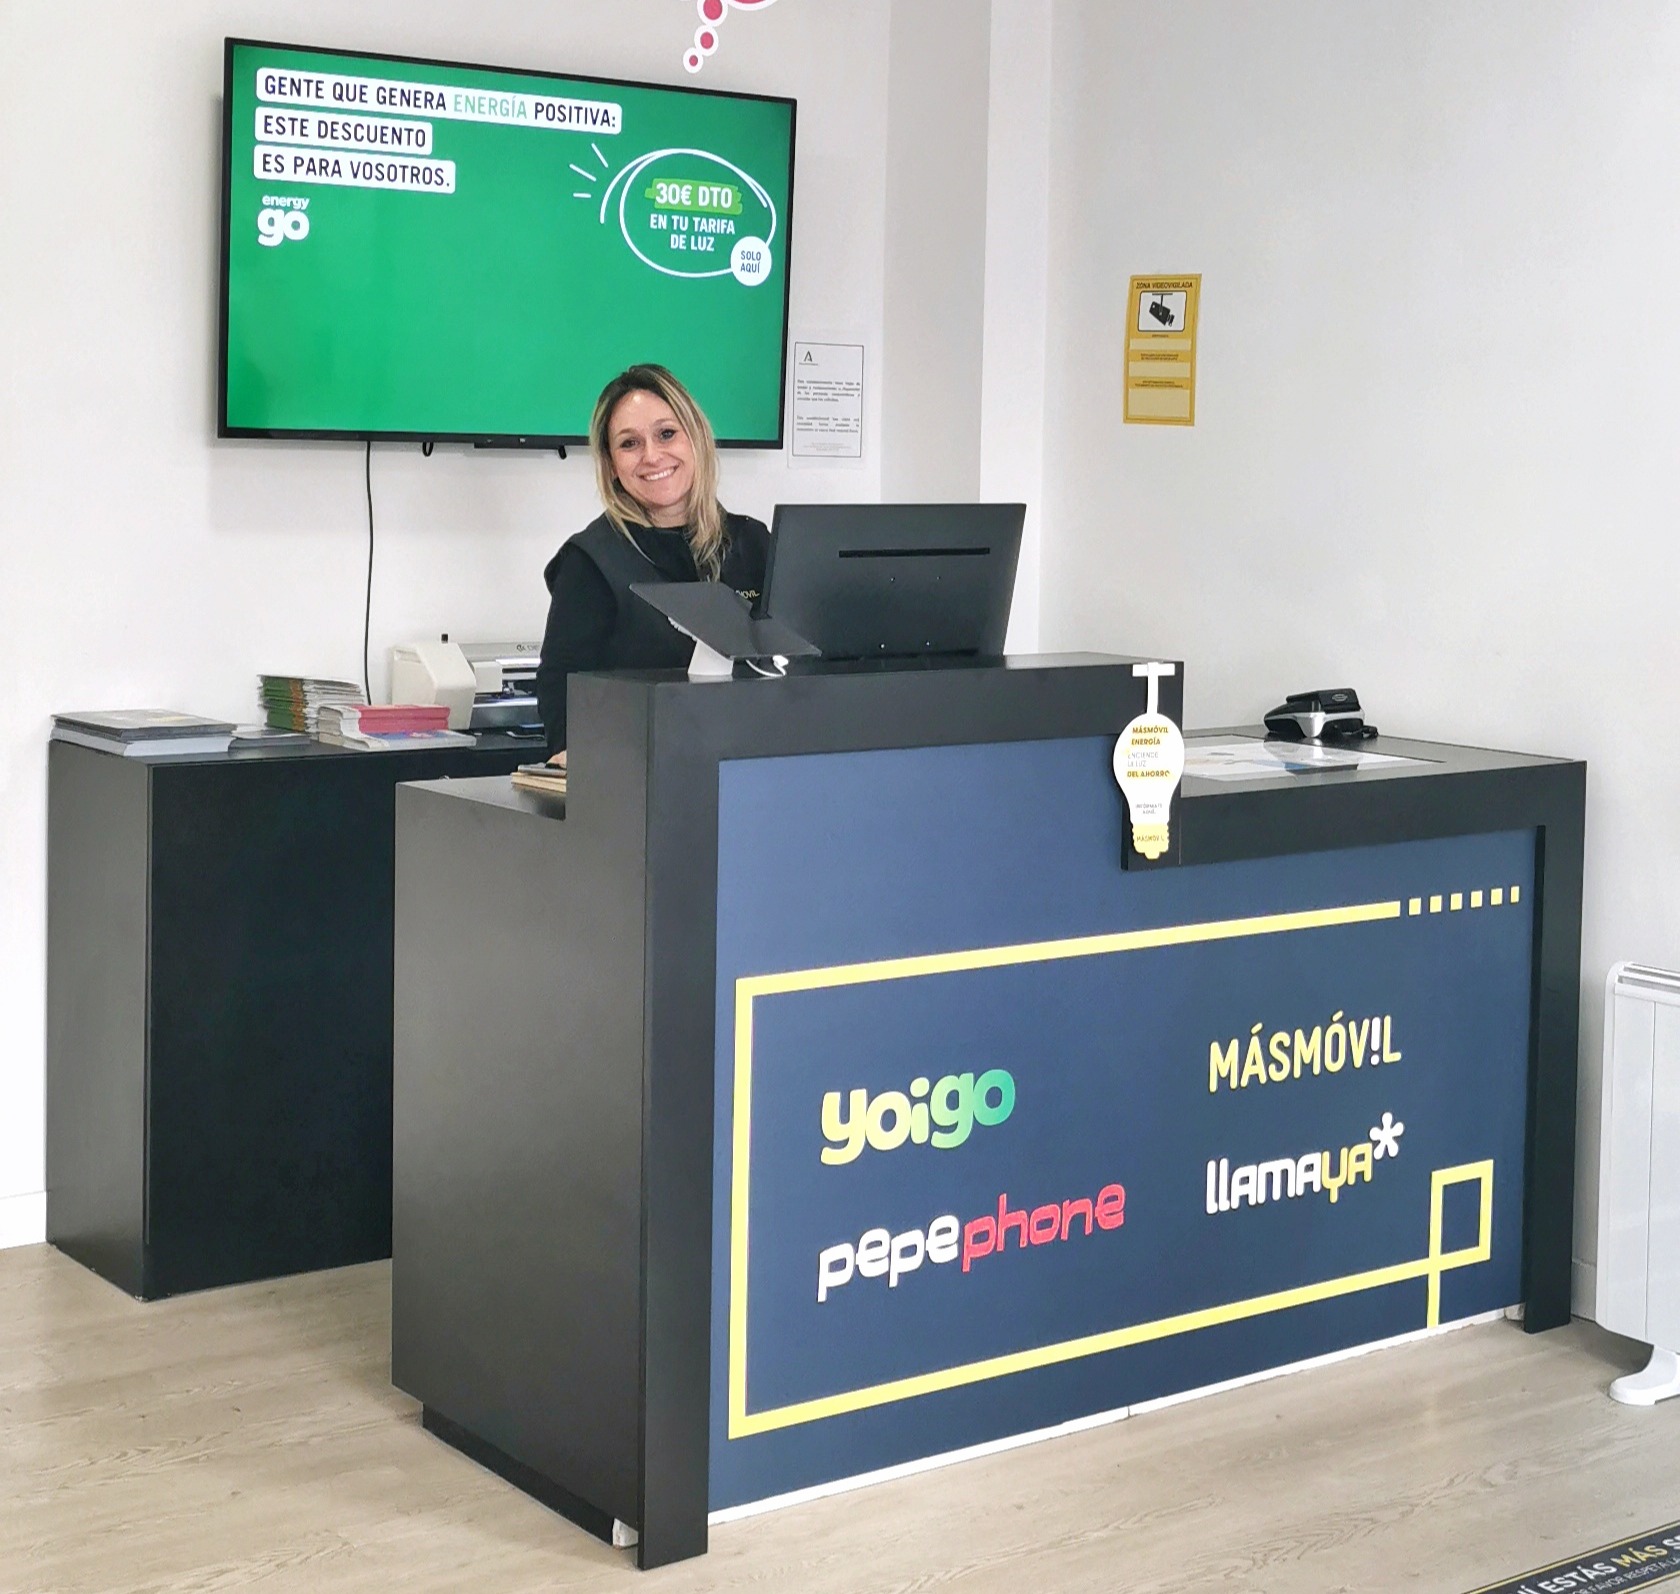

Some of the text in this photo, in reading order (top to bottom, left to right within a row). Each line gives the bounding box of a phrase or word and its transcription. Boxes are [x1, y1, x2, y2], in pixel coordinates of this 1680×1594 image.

[264, 75, 616, 128] GENTE QUE GENERA ENERGÍA POSITIVA:
[263, 115, 426, 148] ESTE DESCUENTO
[262, 153, 450, 187] ES PARA VOSOTROS.
[261, 194, 310, 210] energy
[655, 182, 733, 209] 30€ DTO
[257, 207, 310, 247] go
[650, 213, 736, 235] EN TU TARIFA
[670, 234, 715, 252] DE LUZ
[740, 250, 762, 262] SOLO
[740, 261, 760, 274] AQUÍ
[1136, 281, 1151, 289] ZONA
[1131, 736, 1161, 746] ENERGÍA
[1127, 769, 1170, 778] DEL AHORRO
[820, 1068, 1016, 1165] yoigo
[817, 1183, 1126, 1303] pepephone
[1537, 1562, 1618, 1593] ESTÁS
[1610, 1545, 1668, 1568] MÁS
